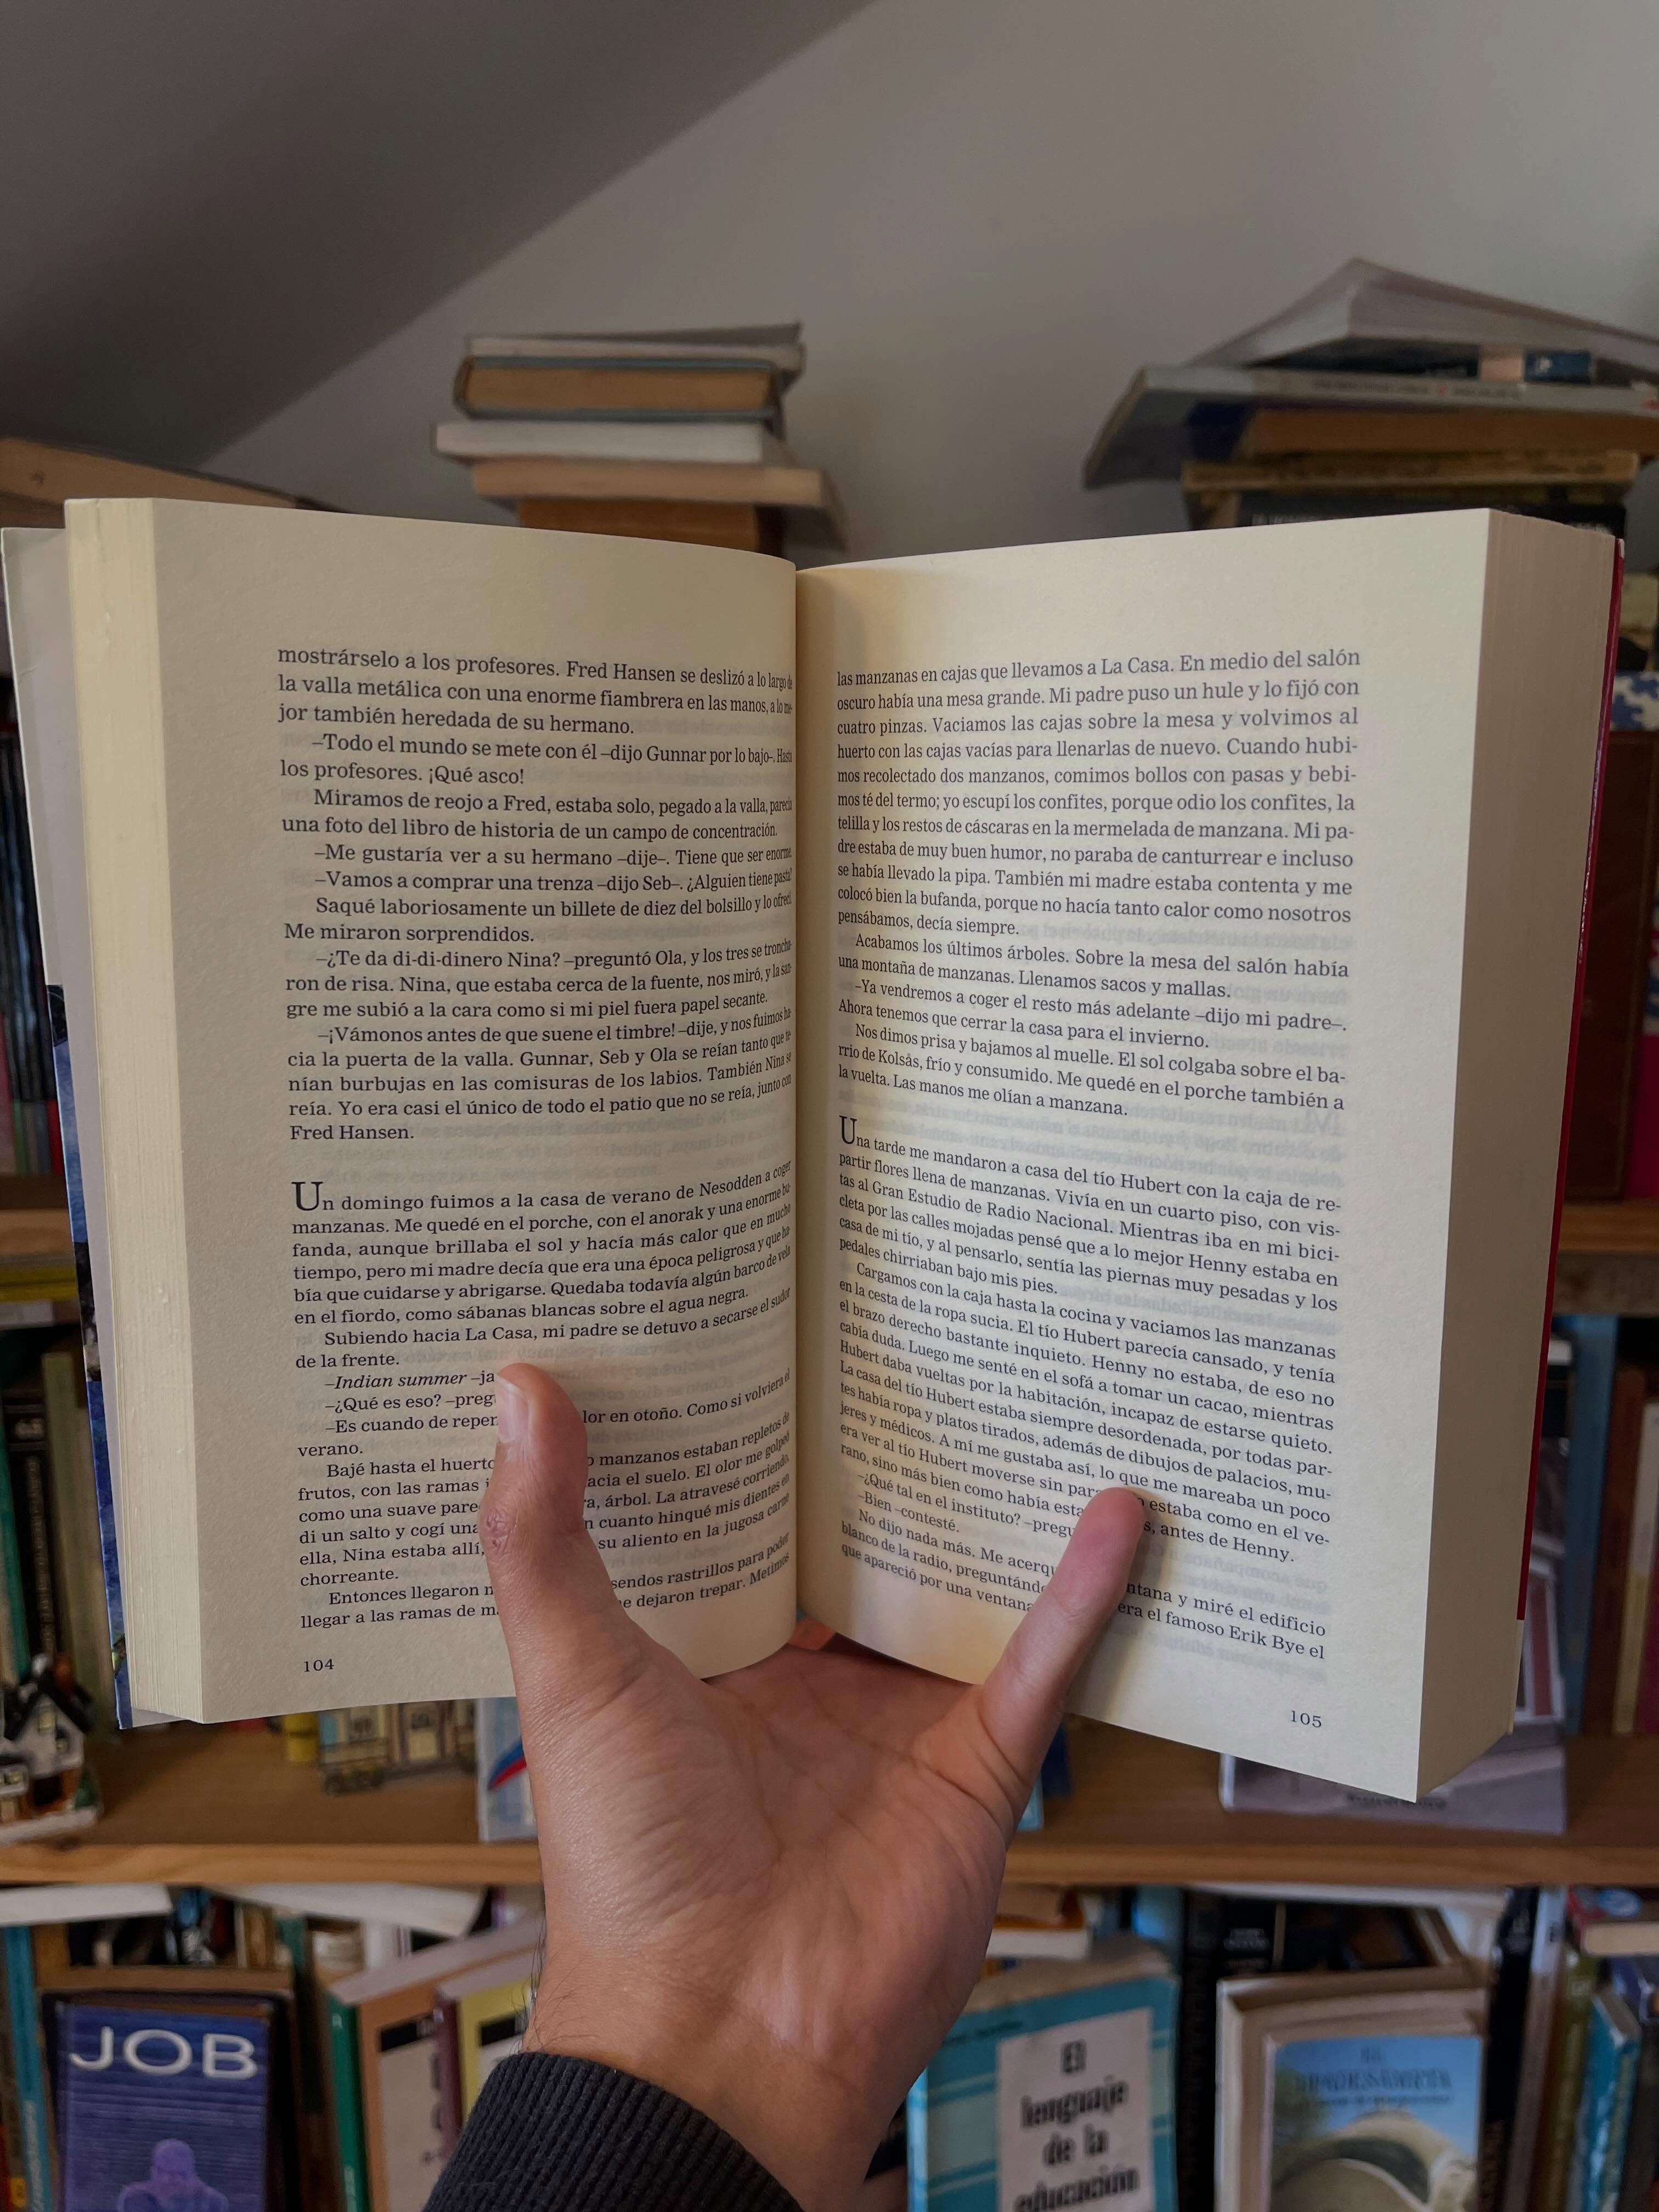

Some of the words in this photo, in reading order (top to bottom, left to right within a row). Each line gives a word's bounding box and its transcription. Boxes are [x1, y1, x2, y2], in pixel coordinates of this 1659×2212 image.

[278, 649, 399, 668] mostrárselo
[405, 657, 416, 669] a
[422, 653, 450, 670] los
[456, 657, 559, 676] profesores.
[567, 661, 607, 678] Fred
[613, 664, 675, 681] Hansen
[681, 671, 696, 682] se
[701, 668, 744, 685] deslizó
[748, 675, 754, 686] a
[757, 672, 766, 687] lo
[769, 673, 786, 691] largo
[837, 672, 853, 686] las
[856, 672, 917, 685] manzanas
[922, 671, 937, 681] en
[941, 665, 977, 683] cajas
[981, 667, 1007, 682] que
[1012, 663, 1082, 678] llevamos
[1088, 663, 1096, 674] a
[1102, 659, 1122, 674] La
[1128, 658, 1173, 673] Casa.
[1181, 656, 1204, 671] En
[1211, 652, 1267, 670] medio
[1274, 651, 1301, 667] del
[1308, 650, 1359, 666] salón
[278, 703, 308, 723] jor
[314, 706, 395, 724] también
[402, 708, 491, 728] heredada
[497, 713, 518, 729] de
[523, 718, 544, 730] su
[550, 715, 633, 733] hermano.
[281, 759, 308, 776] los
[314, 763, 422, 780] profesores.
[430, 766, 472, 784] ¡Qué
[478, 769, 523, 784] asco!
[282, 819, 320, 832] una
[325, 817, 362, 833] foto
[369, 818, 397, 834] del
[403, 819, 449, 836] libro
[455, 821, 476, 836] de
[482, 821, 555, 838] historia
[560, 823, 580, 838] de
[585, 827, 608, 839] un
[613, 828, 667, 842] campo
[672, 824, 689, 839] de
[693, 823, 777, 839] concentración.
[285, 923, 314, 939] Me
[320, 924, 401, 940] miraron
[407, 927, 534, 944] sorprendidos.
[838, 911, 912, 930] pensábamos,
[917, 915, 952, 930] decía
[957, 918, 1018, 936] siempre.
[838, 957, 859, 969] una
[862, 960, 915, 975] montaña
[919, 962, 934, 977] de
[938, 968, 1013, 983] manzanas.
[1019, 970, 1096, 989] Llenamos
[1102, 979, 1146, 992] sacos
[1152, 983, 1161, 996] y
[1167, 981, 1230, 997] mallas.
[839, 999, 873, 1016] Ahora
[876, 1005, 928, 1023] tenemos
[933, 1014, 956, 1027] que
[961, 1017, 1007, 1030] cerrar
[1011, 1018, 1024, 1032] la
[1029, 1024, 1063, 1036] casa
[1068, 1026, 1104, 1040] para
[1110, 1027, 1124, 1041] el
[1130, 1028, 1208, 1047] invierno.
[839, 1064, 848, 1079] la
[851, 1070, 889, 1086] vuelta.
[894, 1074, 915, 1090] Las
[919, 1081, 963, 1096] manos
[968, 1088, 989, 1099] me
[994, 1088, 1031, 1105] olían
[1036, 1097, 1045, 1107] a
[1049, 1097, 1127, 1115] manzana.
[290, 1125, 334, 1139] Fred
[339, 1126, 414, 1139] Hansen.
[839, 1115, 870, 1149] Una
[874, 1138, 905, 1155] tarde
[910, 1148, 929, 1159] me
[934, 1152, 1006, 1172] mandaron
[1012, 1164, 1020, 1173] a
[1025, 1166, 1058, 1179] casa
[1064, 1167, 1087, 1183] del
[1093, 1172, 1114, 1186] tío
[1120, 1174, 1181, 1194] Hubert
[1187, 1185, 1217, 1198] con
[1223, 1185, 1239, 1200] la
[1246, 1190, 1282, 1206] caja
[1289, 1193, 1310, 1208] de
[1317, 1199, 1340, 1211] re-
[291, 1182, 334, 1211] Un
[342, 1196, 423, 1212] domingo
[431, 1195, 494, 1209] fuimos
[501, 1198, 511, 1207] a
[517, 1194, 533, 1207] la
[540, 1196, 579, 1206] casa
[586, 1192, 605, 1205] de
[612, 1190, 670, 1204] verano
[676, 1186, 693, 1199] de
[699, 1175, 761, 1197] Nesodden
[765, 1172, 770, 1182] a
[774, 1161, 791, 1178] coger
[839, 1238, 880, 1258] pedales
[884, 1248, 953, 1276] chirriaban
[957, 1264, 986, 1282] bajo
[991, 1273, 1018, 1287] mis
[1023, 1278, 1057, 1294] pies.
[295, 1314, 316, 1324] en
[321, 1310, 337, 1323] el
[341, 1309, 399, 1323] fiordo,
[406, 1310, 452, 1321] como
[457, 1306, 526, 1319] sábanas
[532, 1303, 596, 1317] blancas
[600, 1301, 645, 1314] sobre
[650, 1300, 664, 1313] el
[668, 1298, 704, 1313] agua
[708, 1289, 748, 1306] negra.
[296, 1355, 316, 1368] de
[321, 1355, 337, 1367] la
[342, 1354, 399, 1367] frente.
[398, 1375, 467, 1386] summer
[301, 1568, 399, 1587] chorreante.
[301, 1615, 350, 1629] llegar
[356, 1614, 365, 1623] a
[371, 1610, 394, 1622] las
[399, 1609, 452, 1620] ramas
[457, 1605, 476, 1617] de
[637, 1592, 694, 1608] dejaron
[700, 1578, 746, 1598] trepar.
[749, 1556, 789, 1585] Metimos
[1118, 1602, 1143, 1618] era
[1148, 1609, 1161, 1622] el
[1166, 1611, 1224, 1636] famoso
[1229, 1625, 1267, 1646] Erik
[1272, 1635, 1304, 1654] Bye
[1310, 1646, 1324, 1659] el
[304, 1659, 334, 1672] 104
[1291, 1711, 1321, 1728] 105
[69, 2027, 258, 2080] JOB
[1019, 2075, 1129, 2129] lenguaje
[1043, 2132, 1075, 2167] de
[1084, 2123, 1108, 2156] la
